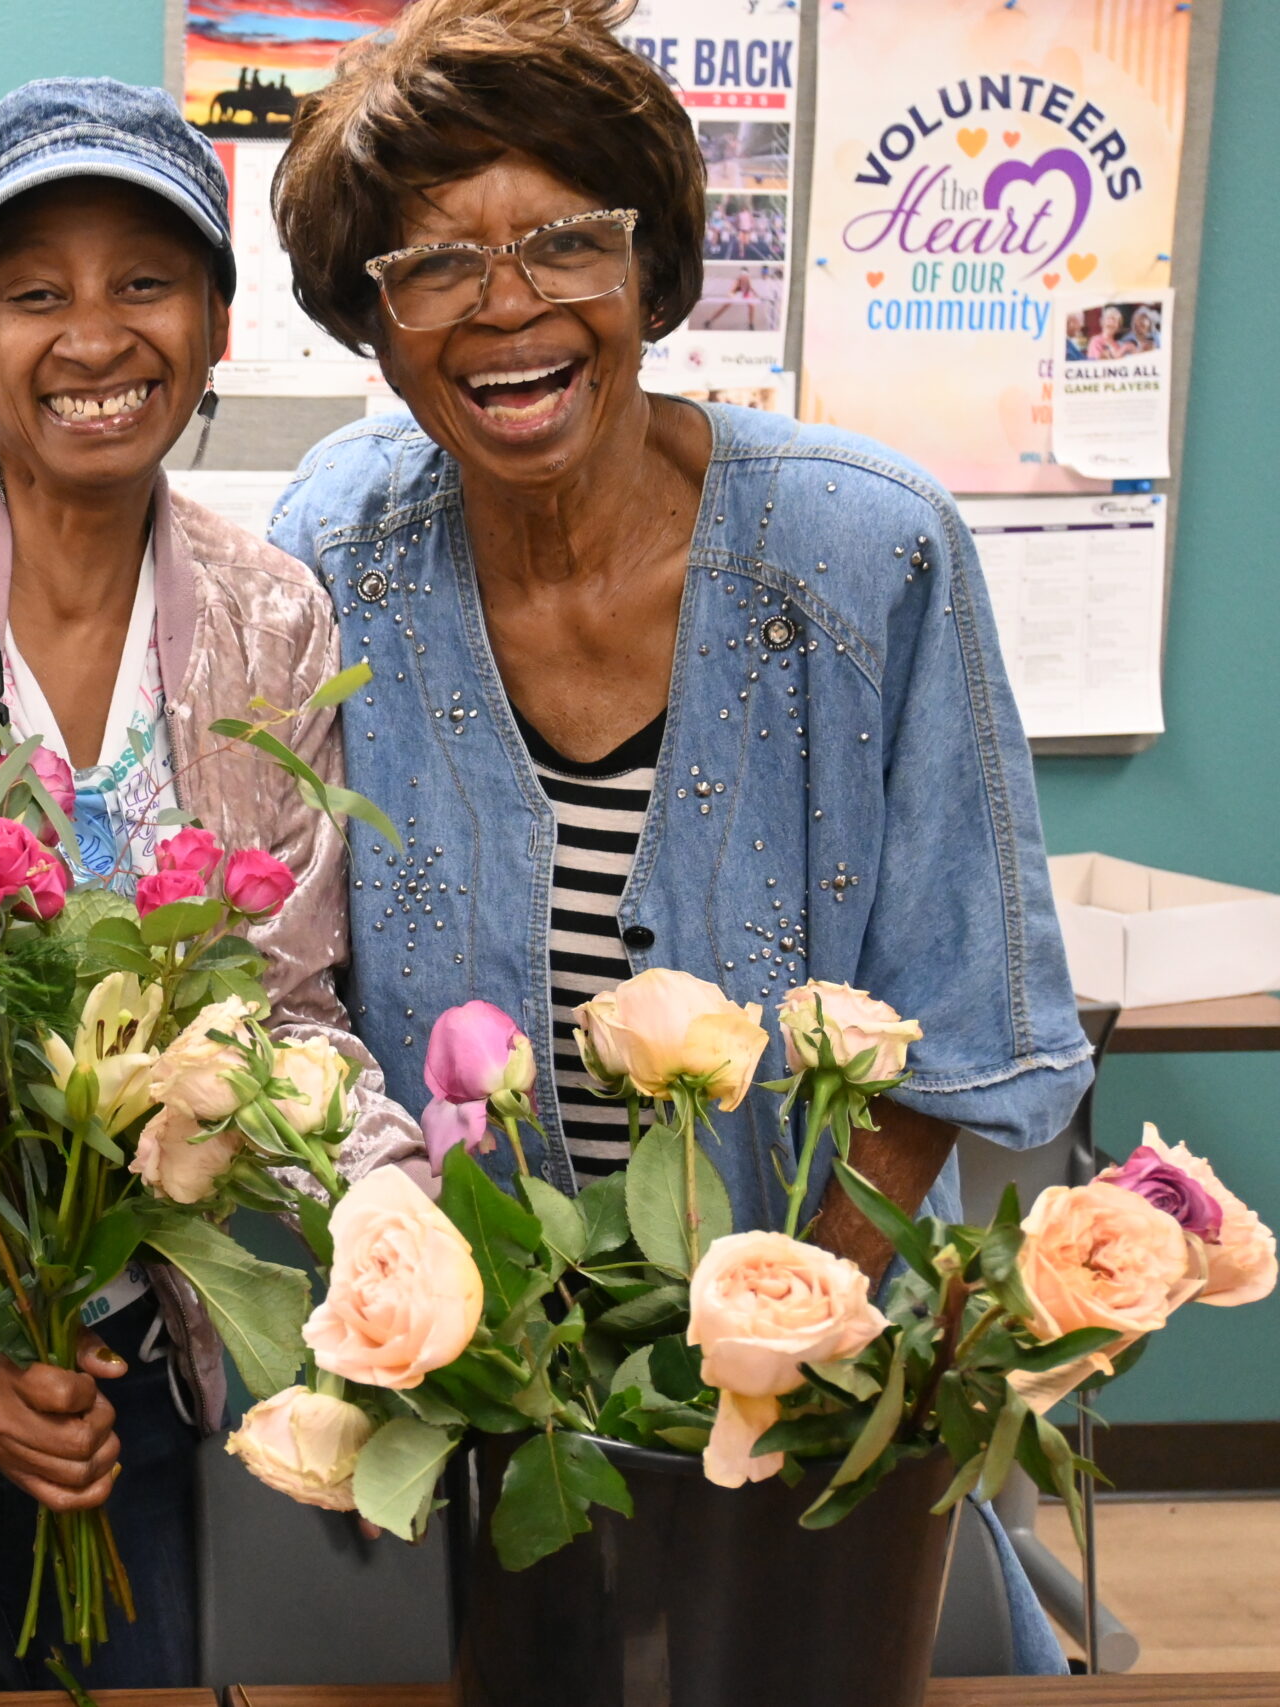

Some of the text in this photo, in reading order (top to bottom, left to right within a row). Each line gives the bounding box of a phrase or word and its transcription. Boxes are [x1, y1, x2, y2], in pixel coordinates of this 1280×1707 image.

[694, 38, 793, 88] BACK
[854, 74, 1143, 201] VOLUNTEERS
[842, 163, 1055, 255] Heart
[941, 178, 979, 211] the
[911, 261, 1005, 294] OF OUR
[867, 289, 1051, 340] community
[1064, 365, 1161, 380] CALLING ALL
[1064, 382, 1100, 394] GAME
[1103, 381, 1161, 393] PLAYERS
